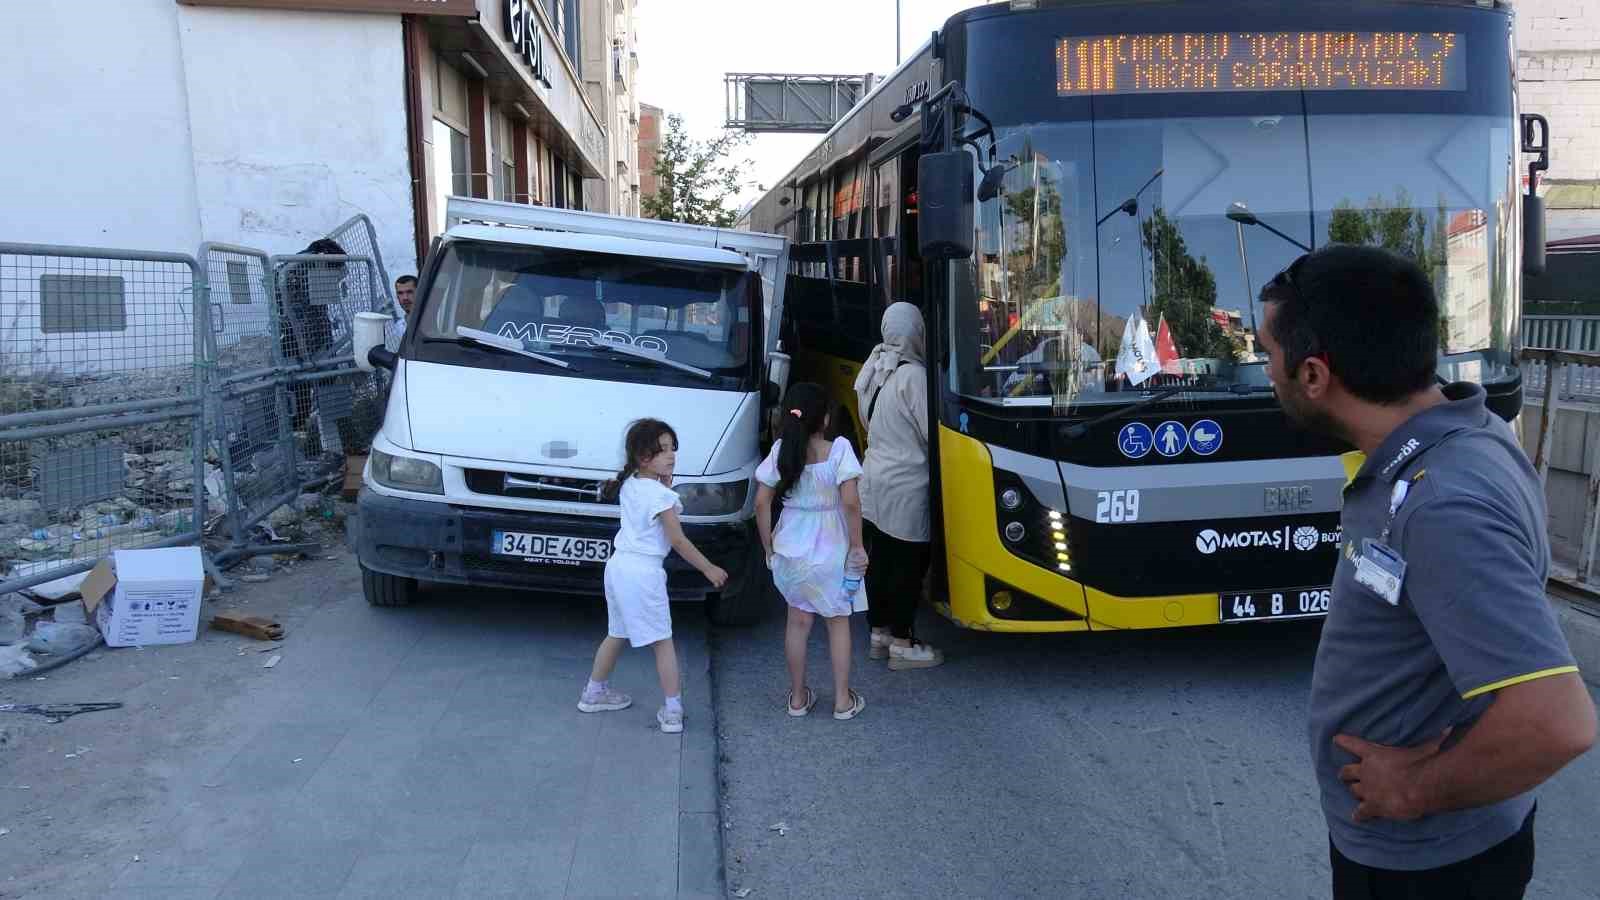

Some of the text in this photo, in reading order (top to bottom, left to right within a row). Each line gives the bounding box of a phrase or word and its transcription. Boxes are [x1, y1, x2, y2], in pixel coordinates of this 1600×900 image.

[1095, 489, 1140, 524] 269
[503, 534, 610, 561] 34 DE 4953
[1221, 530, 1283, 549] MOTAŞ
[1232, 590, 1330, 617] 44 B 026
